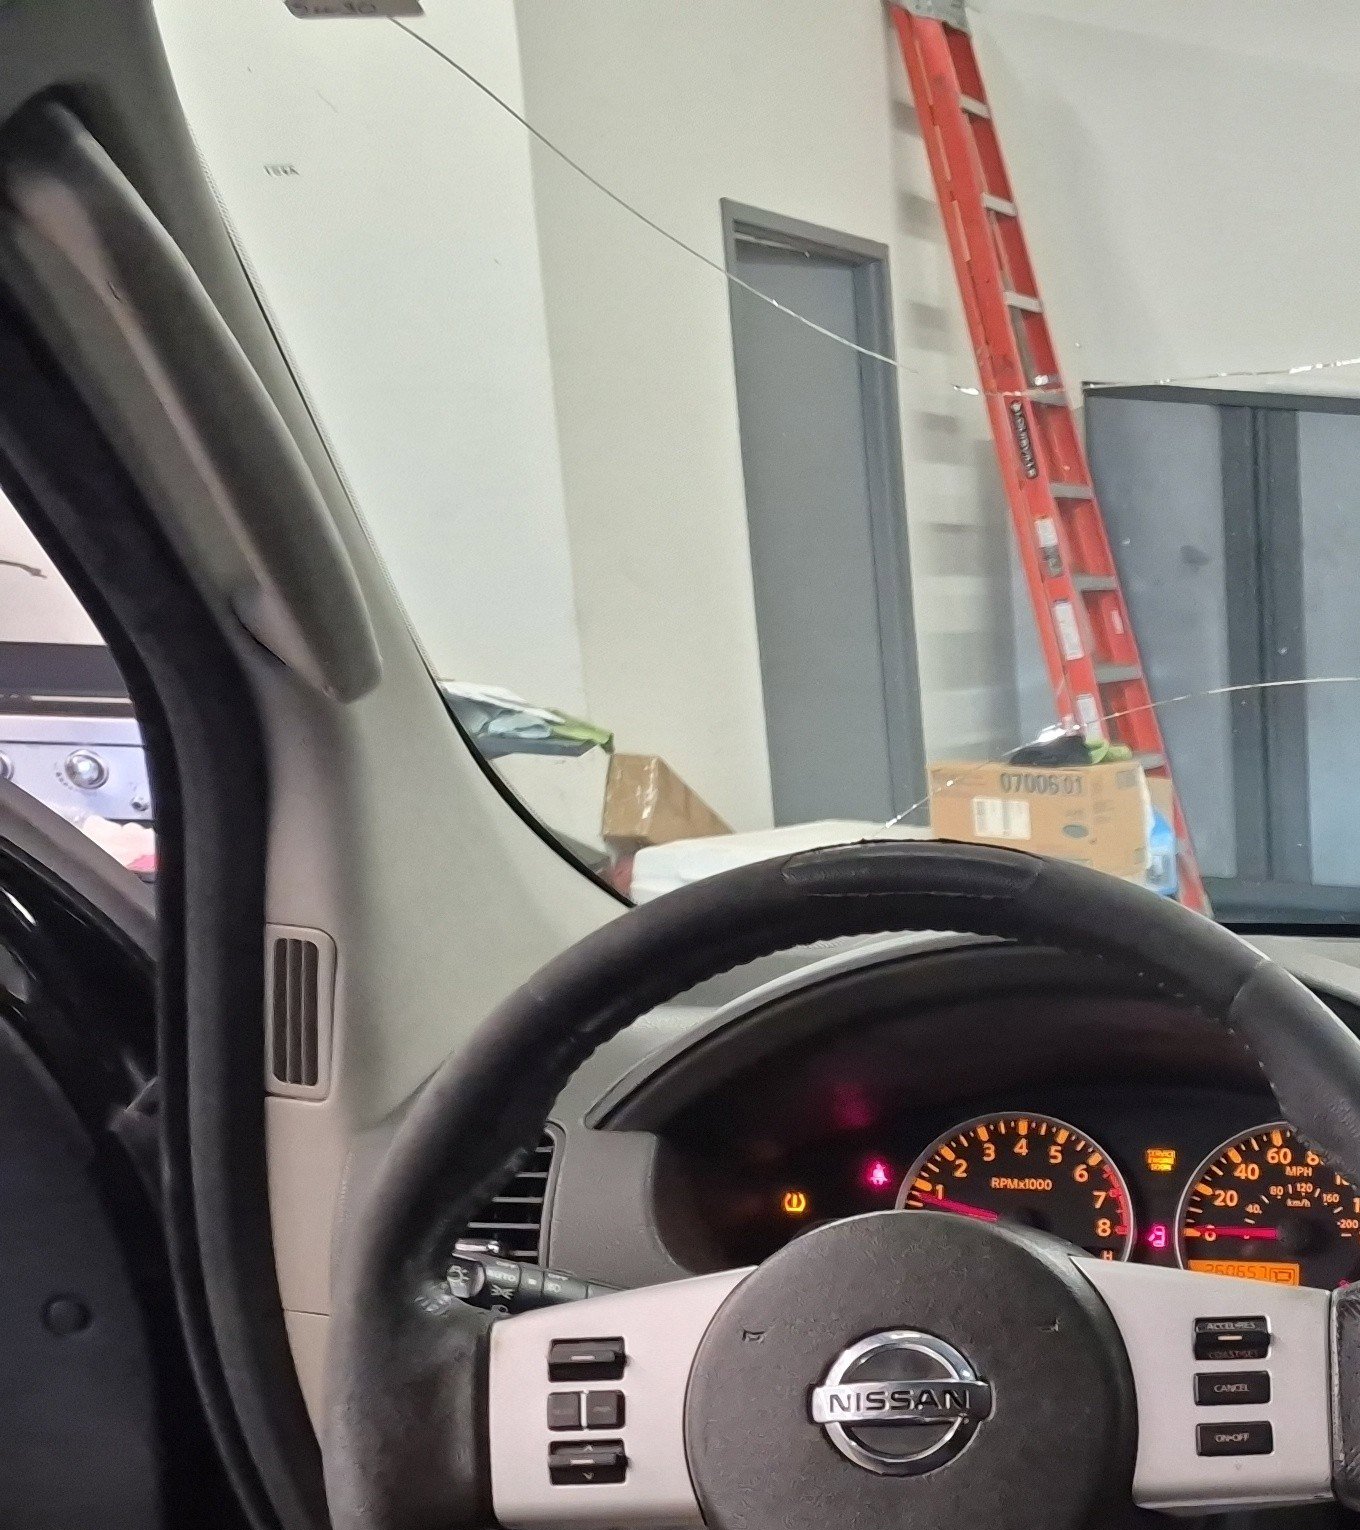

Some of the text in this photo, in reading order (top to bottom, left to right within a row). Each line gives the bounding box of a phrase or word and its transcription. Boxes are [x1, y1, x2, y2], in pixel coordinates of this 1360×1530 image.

[983, 1141, 996, 1162] 3
[1013, 1137, 1029, 1156] 4
[1049, 1145, 1062, 1164] 5
[1266, 1147, 1292, 1165] 60
[953, 1158, 968, 1178] 2
[1073, 1164, 1089, 1183] 6
[1233, 1163, 1260, 1180] 40
[1285, 1165, 1313, 1177] MPH
[935, 1183, 944, 1200] 1
[990, 1176, 1053, 1191] RPMx1000
[1296, 1182, 1313, 1193] 120
[1092, 1190, 1107, 1209] 7
[1212, 1189, 1239, 1207] 20
[1286, 1198, 1311, 1208] km/h
[1322, 1192, 1340, 1203] 160
[1245, 1203, 1261, 1214] 40
[1096, 1217, 1112, 1237] 8
[1340, 1218, 1359, 1229] 200
[1213, 1383, 1250, 1393] CANCEL
[828, 1388, 971, 1413] NISSAN
